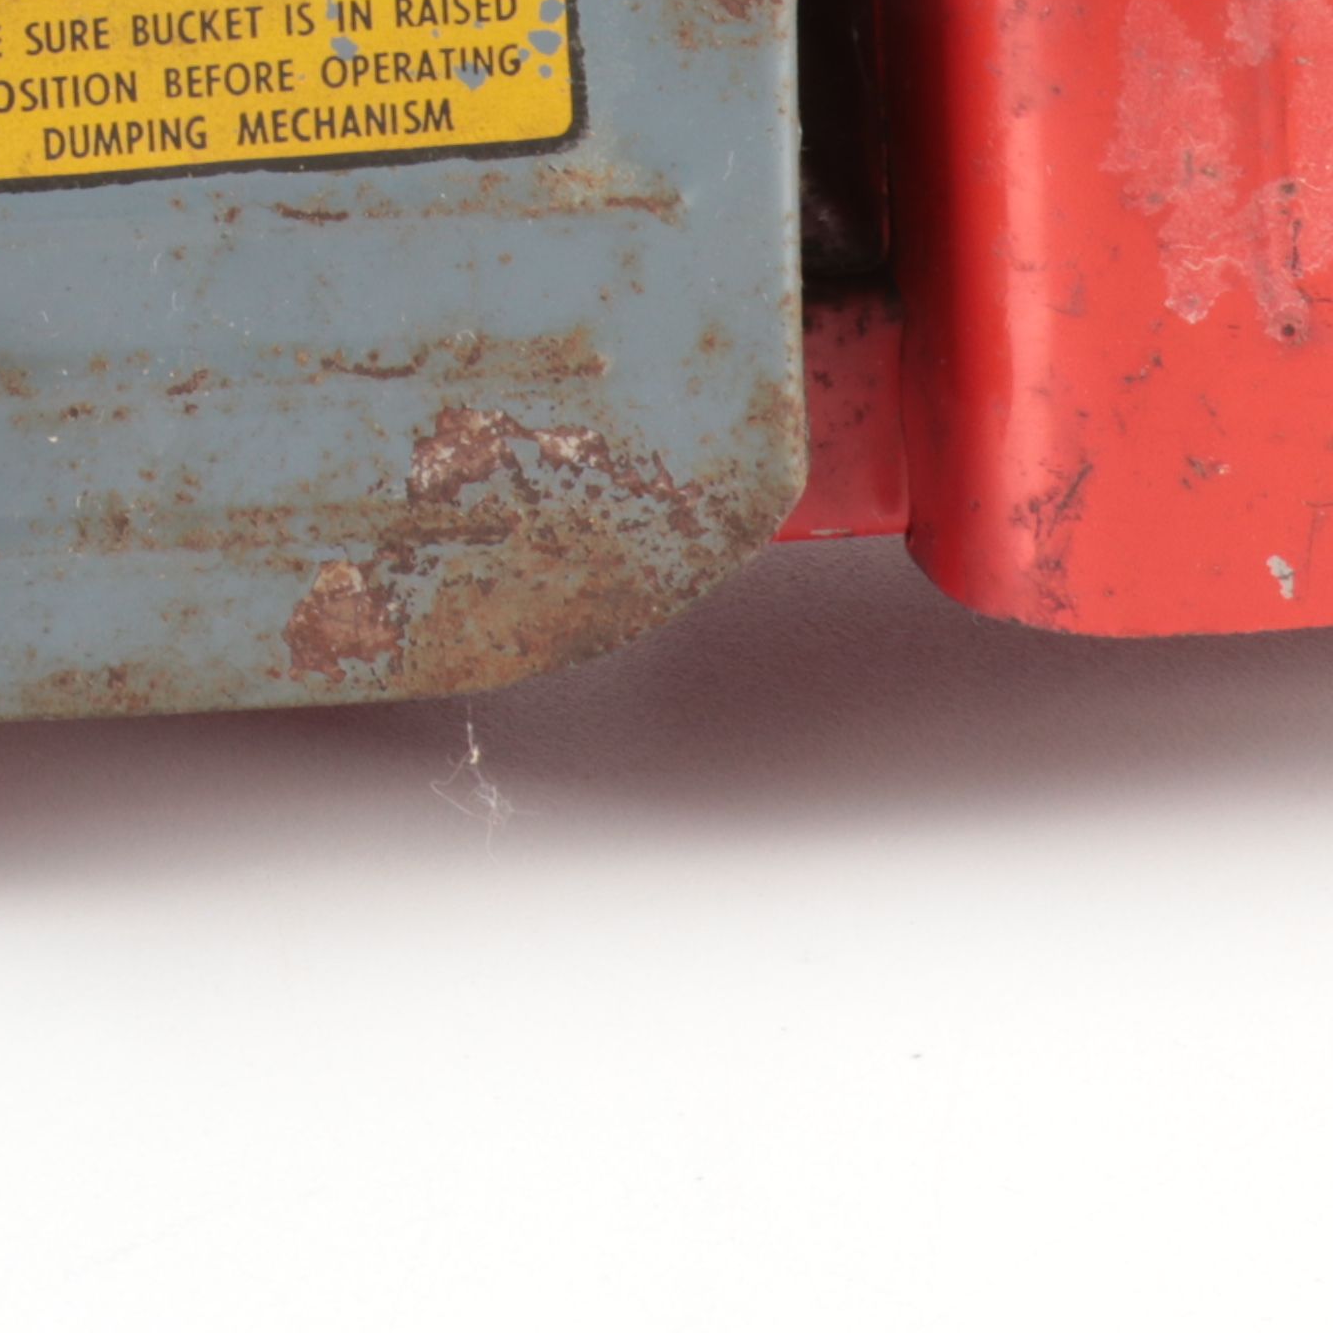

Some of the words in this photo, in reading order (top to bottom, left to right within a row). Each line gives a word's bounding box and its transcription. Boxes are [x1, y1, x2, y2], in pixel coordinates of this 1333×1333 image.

[25, 17, 110, 57] SURE
[132, 6, 264, 47] BUCKET
[285, 2, 316, 37] IS
[164, 59, 295, 99] BEFORE
[320, 44, 522, 89] OPERATING
[43, 115, 208, 161] DUMPING
[237, 97, 455, 146] MECHANISM
